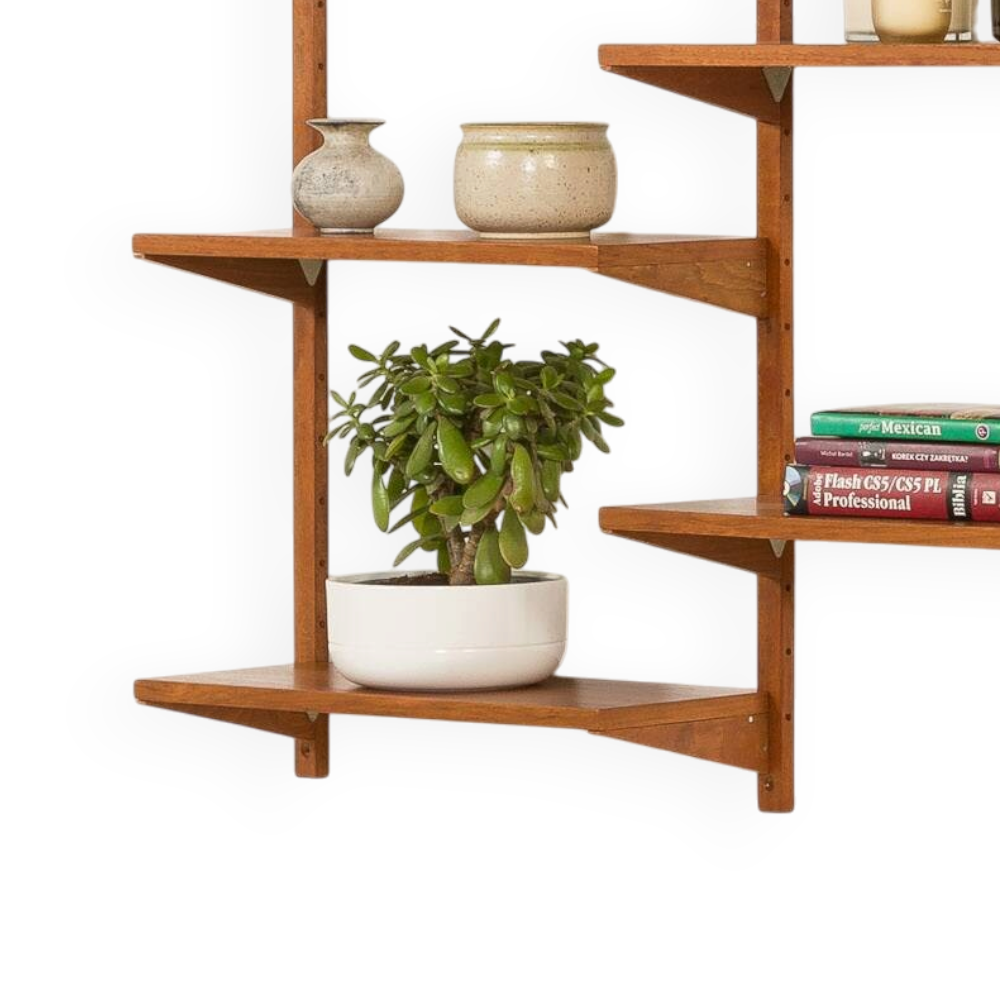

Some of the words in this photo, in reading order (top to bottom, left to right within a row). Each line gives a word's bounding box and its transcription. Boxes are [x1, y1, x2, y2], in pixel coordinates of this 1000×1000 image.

[881, 420, 942, 436] Mexican
[892, 453, 915, 461] KOREK
[915, 453, 929, 462] CZY
[813, 473, 823, 506] Adobe
[824, 473, 862, 490] Flash
[863, 474, 922, 493] CS5/CS5
[924, 477, 942, 493] PL
[824, 492, 912, 511] Professional
[952, 475, 967, 517] Biblia
